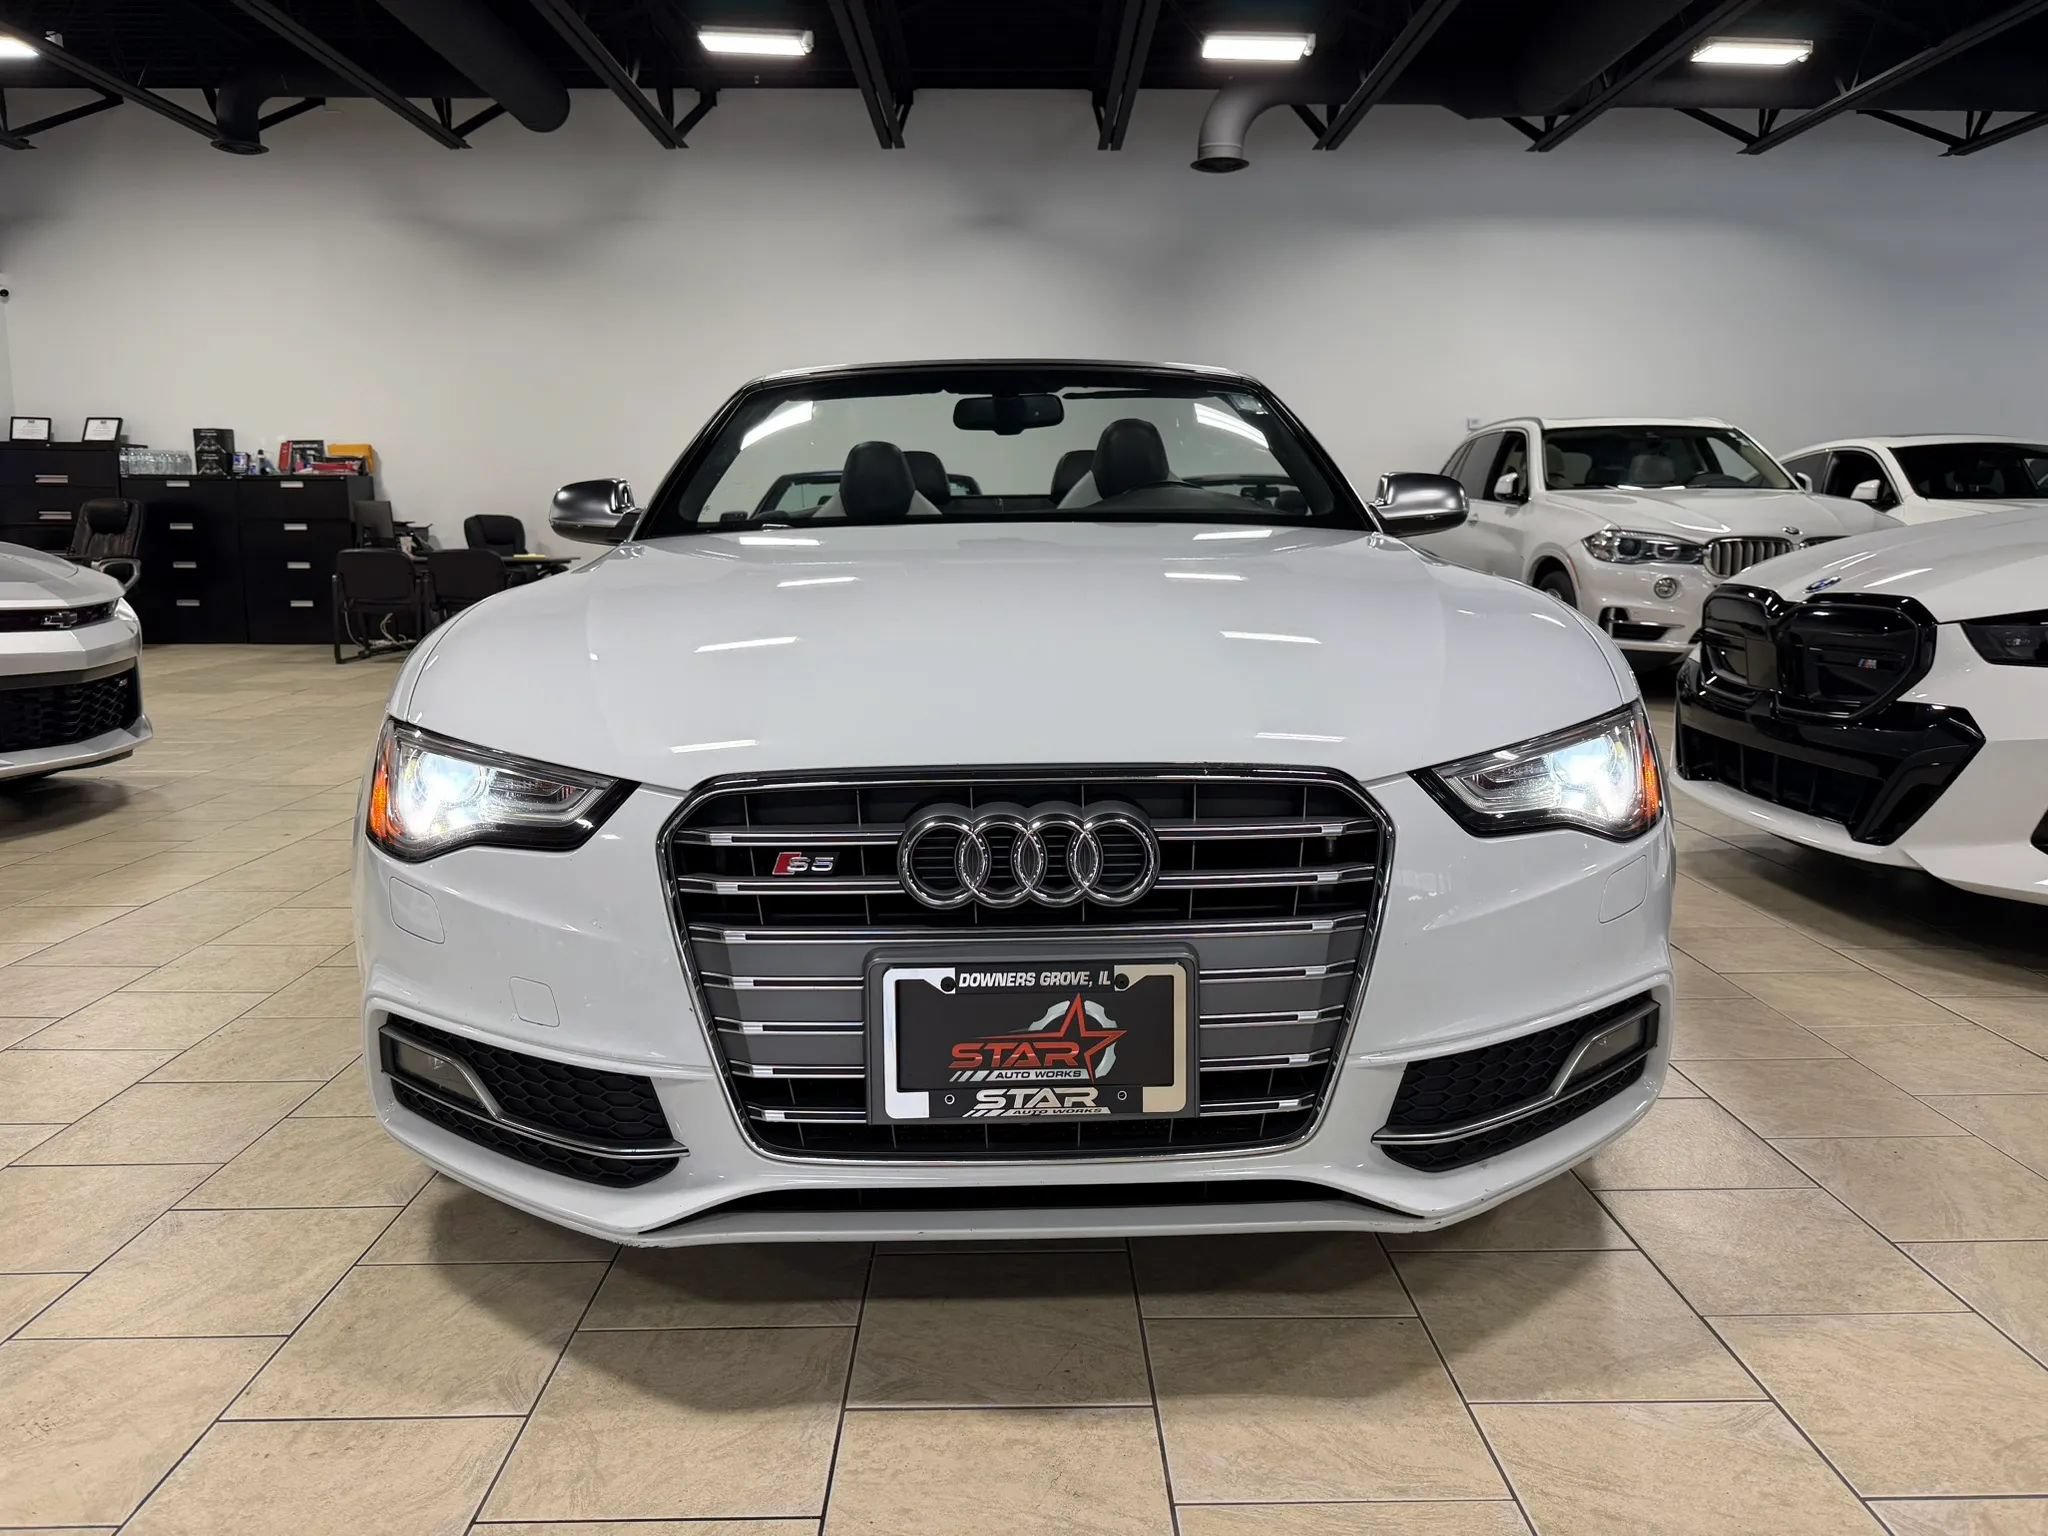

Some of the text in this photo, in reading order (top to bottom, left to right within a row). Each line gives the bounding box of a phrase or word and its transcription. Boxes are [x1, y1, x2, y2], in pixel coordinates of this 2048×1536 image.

[787, 857, 834, 871] S5
[959, 971, 1111, 988] DOWNERS GROVE, IL
[949, 1042, 1080, 1069] STAR
[995, 1070, 1082, 1079] AUTO WORKS
[973, 1087, 1099, 1109] STAR
